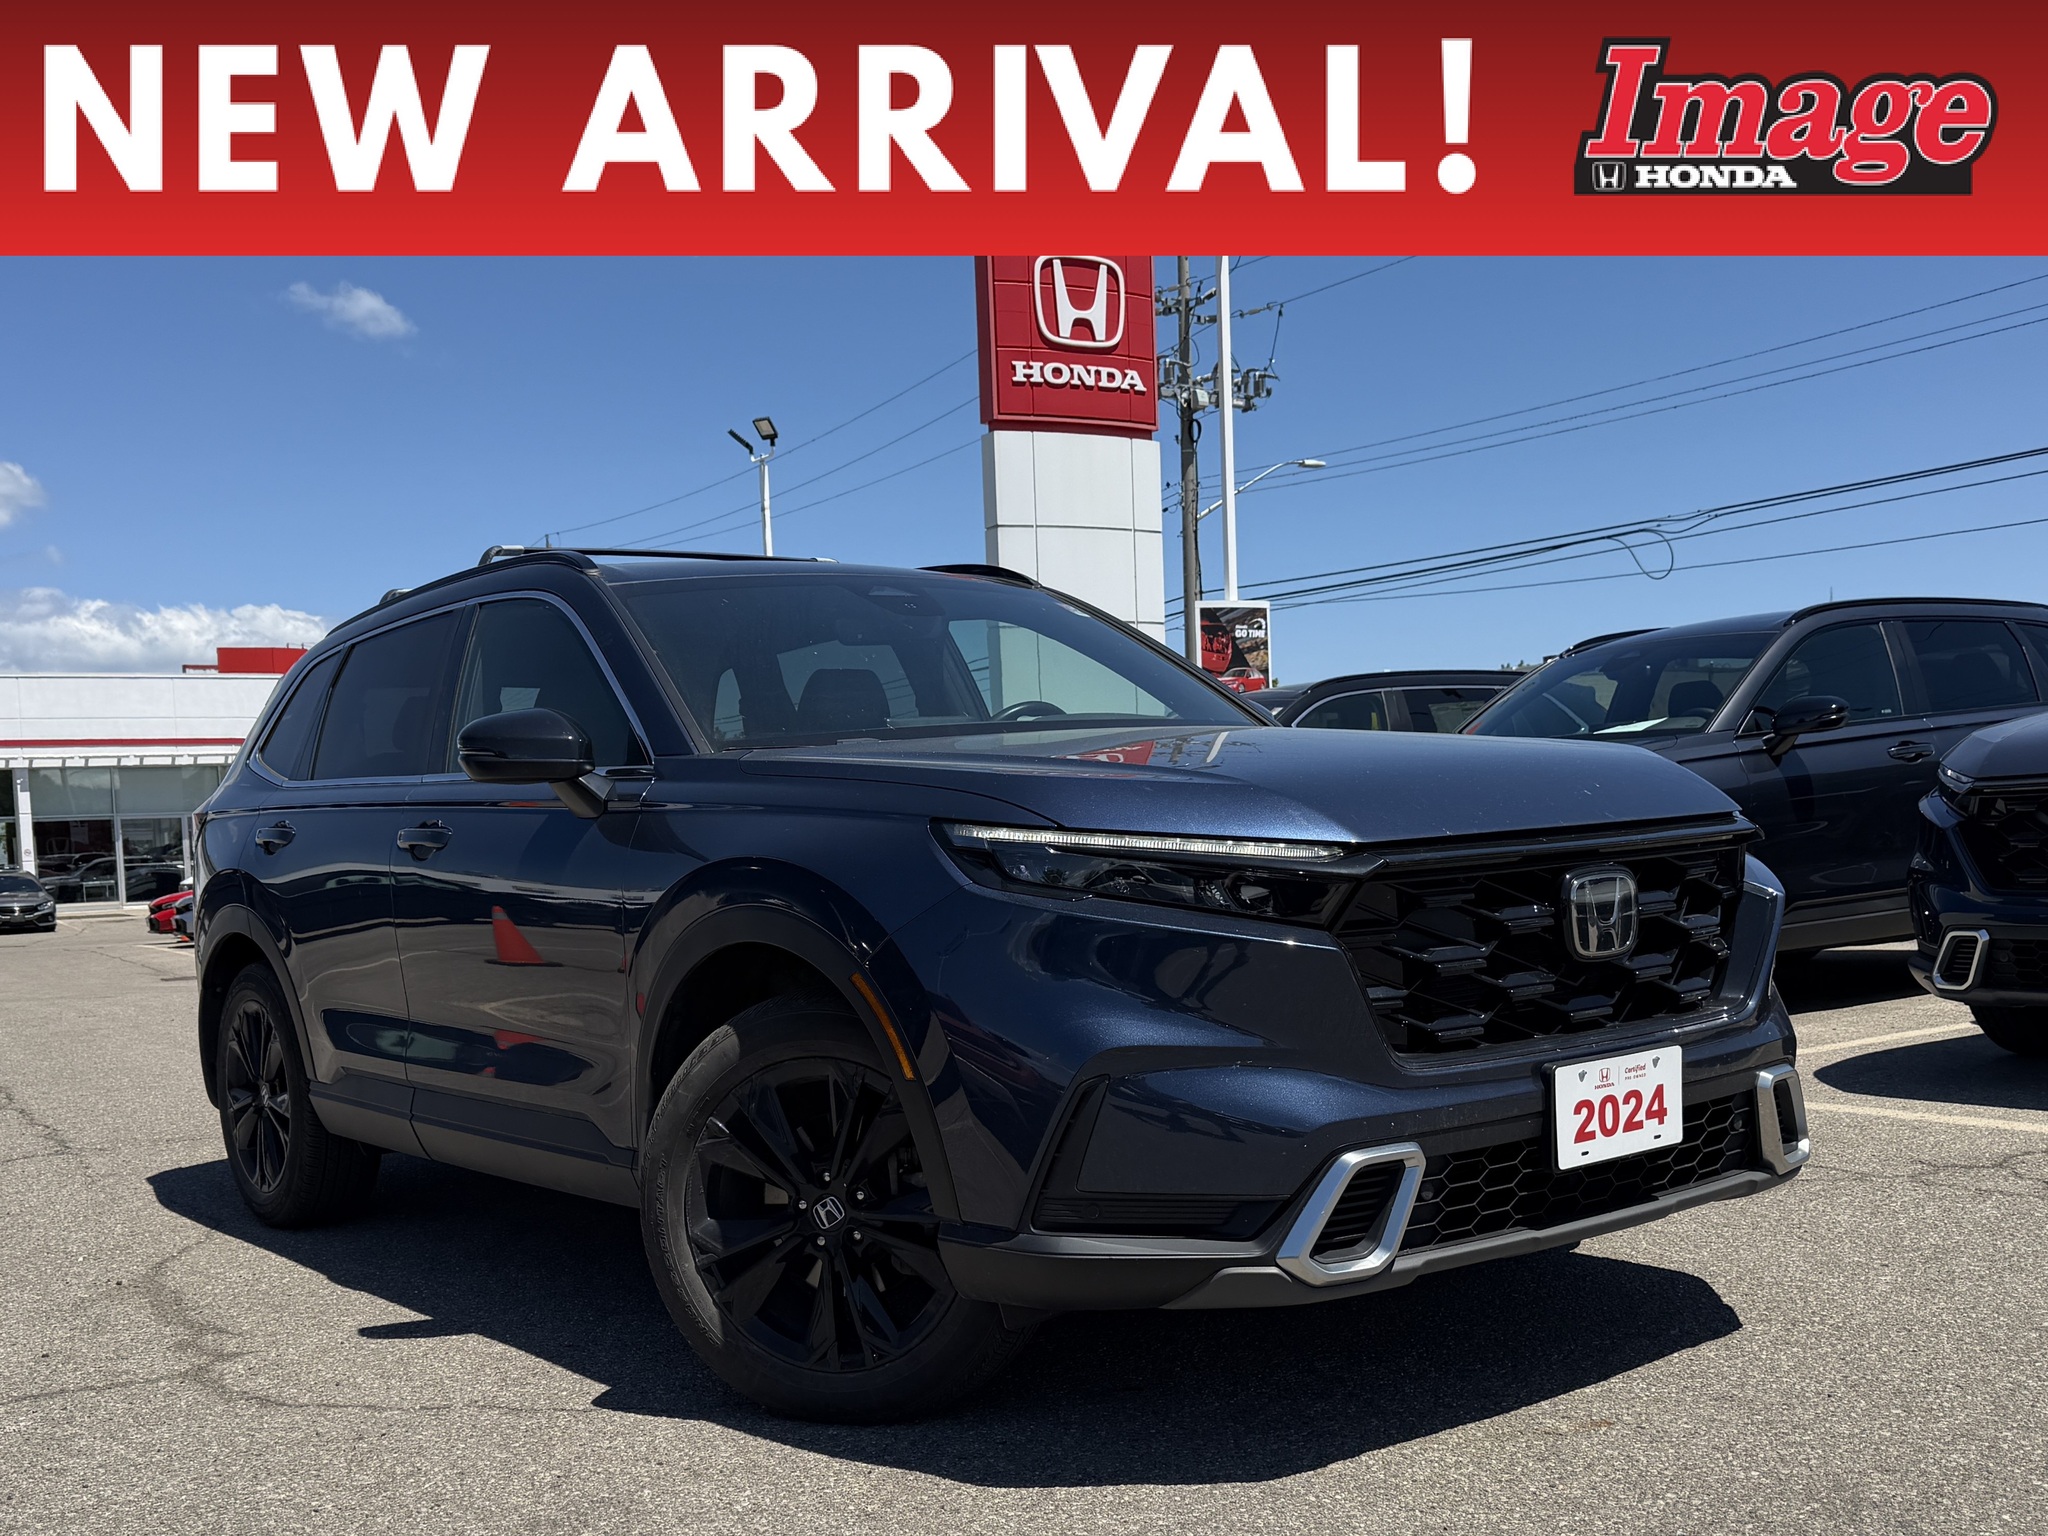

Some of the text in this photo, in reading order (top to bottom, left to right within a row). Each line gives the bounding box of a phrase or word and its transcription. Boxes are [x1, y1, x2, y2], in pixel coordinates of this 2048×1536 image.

[1011, 360, 1147, 393] HONDA
[1235, 629, 1266, 638] GO TIME
[1624, 1064, 1647, 1074] Certified
[1594, 1082, 1615, 1090] HONDA
[1573, 1083, 1668, 1144] 2024
